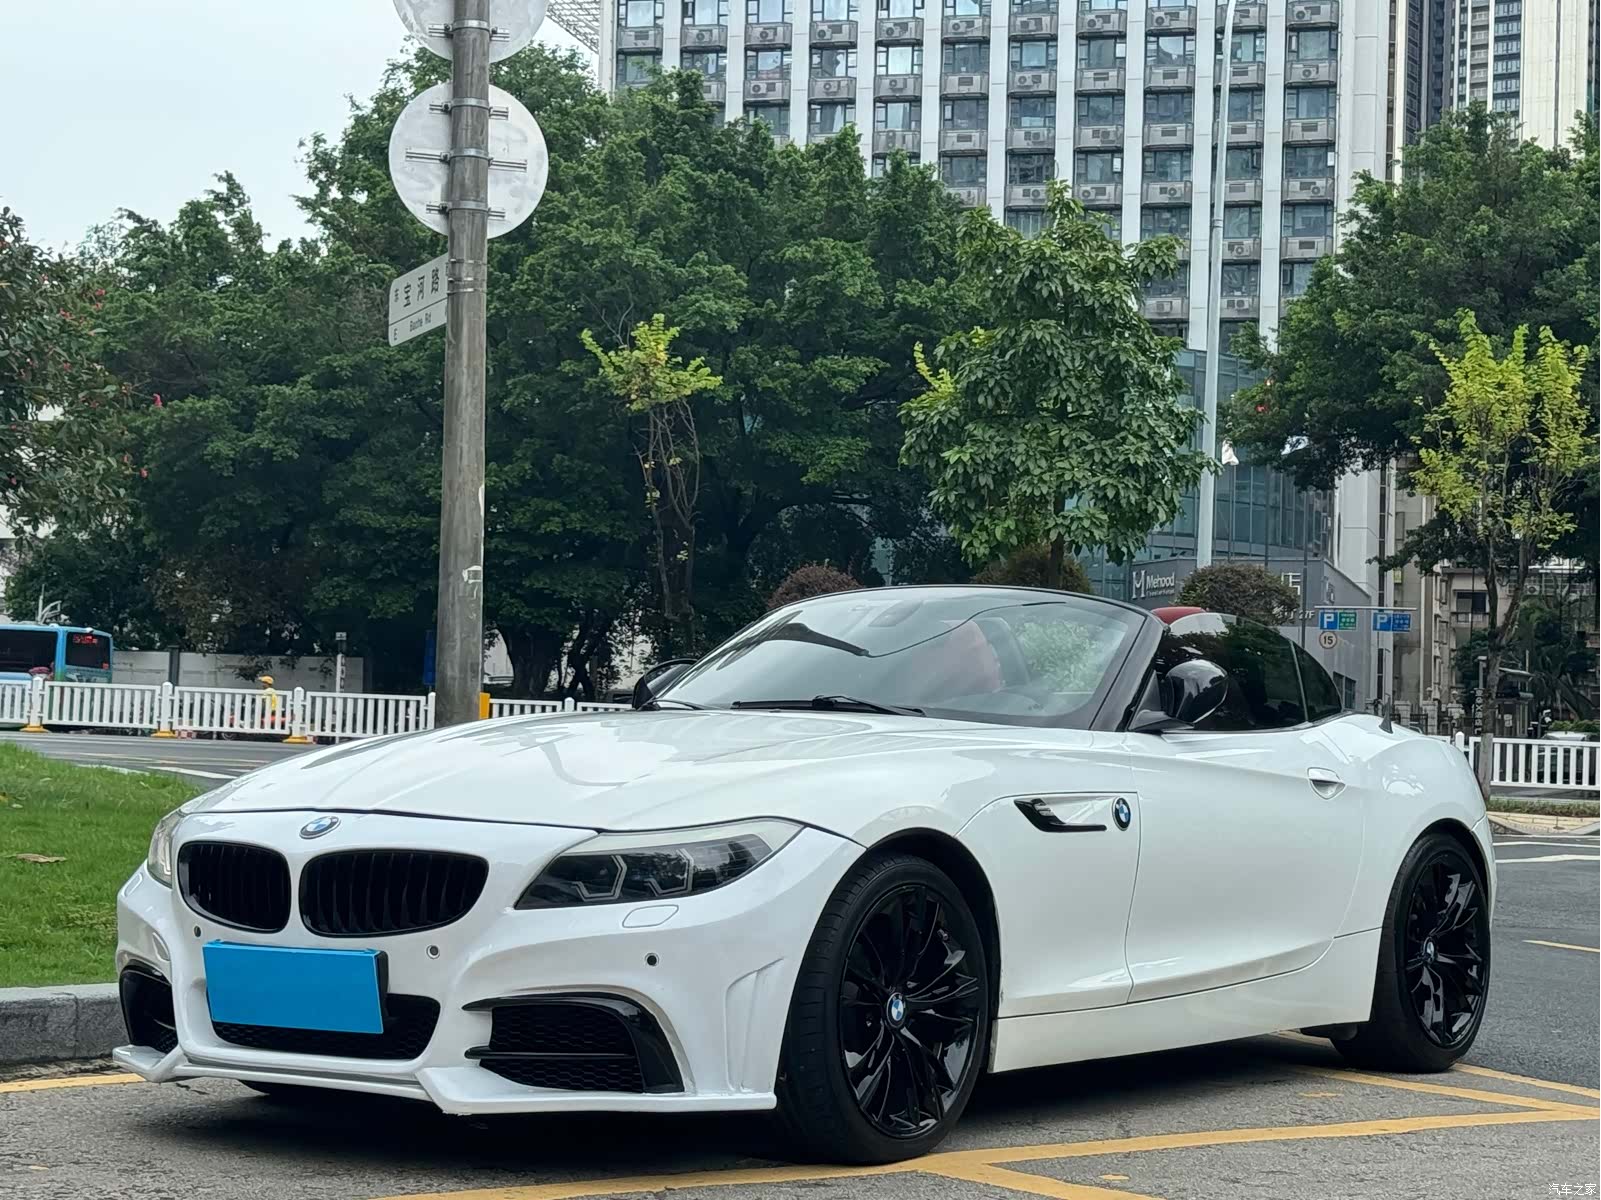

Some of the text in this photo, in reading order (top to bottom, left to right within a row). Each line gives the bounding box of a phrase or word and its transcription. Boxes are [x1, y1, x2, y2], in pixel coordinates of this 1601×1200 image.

[403, 267, 440, 307] 宝河路
[1146, 572, 1175, 590] Mehood
[1323, 613, 1335, 629] P
[1376, 614, 1388, 630] P
[1323, 635, 1334, 646] 15
